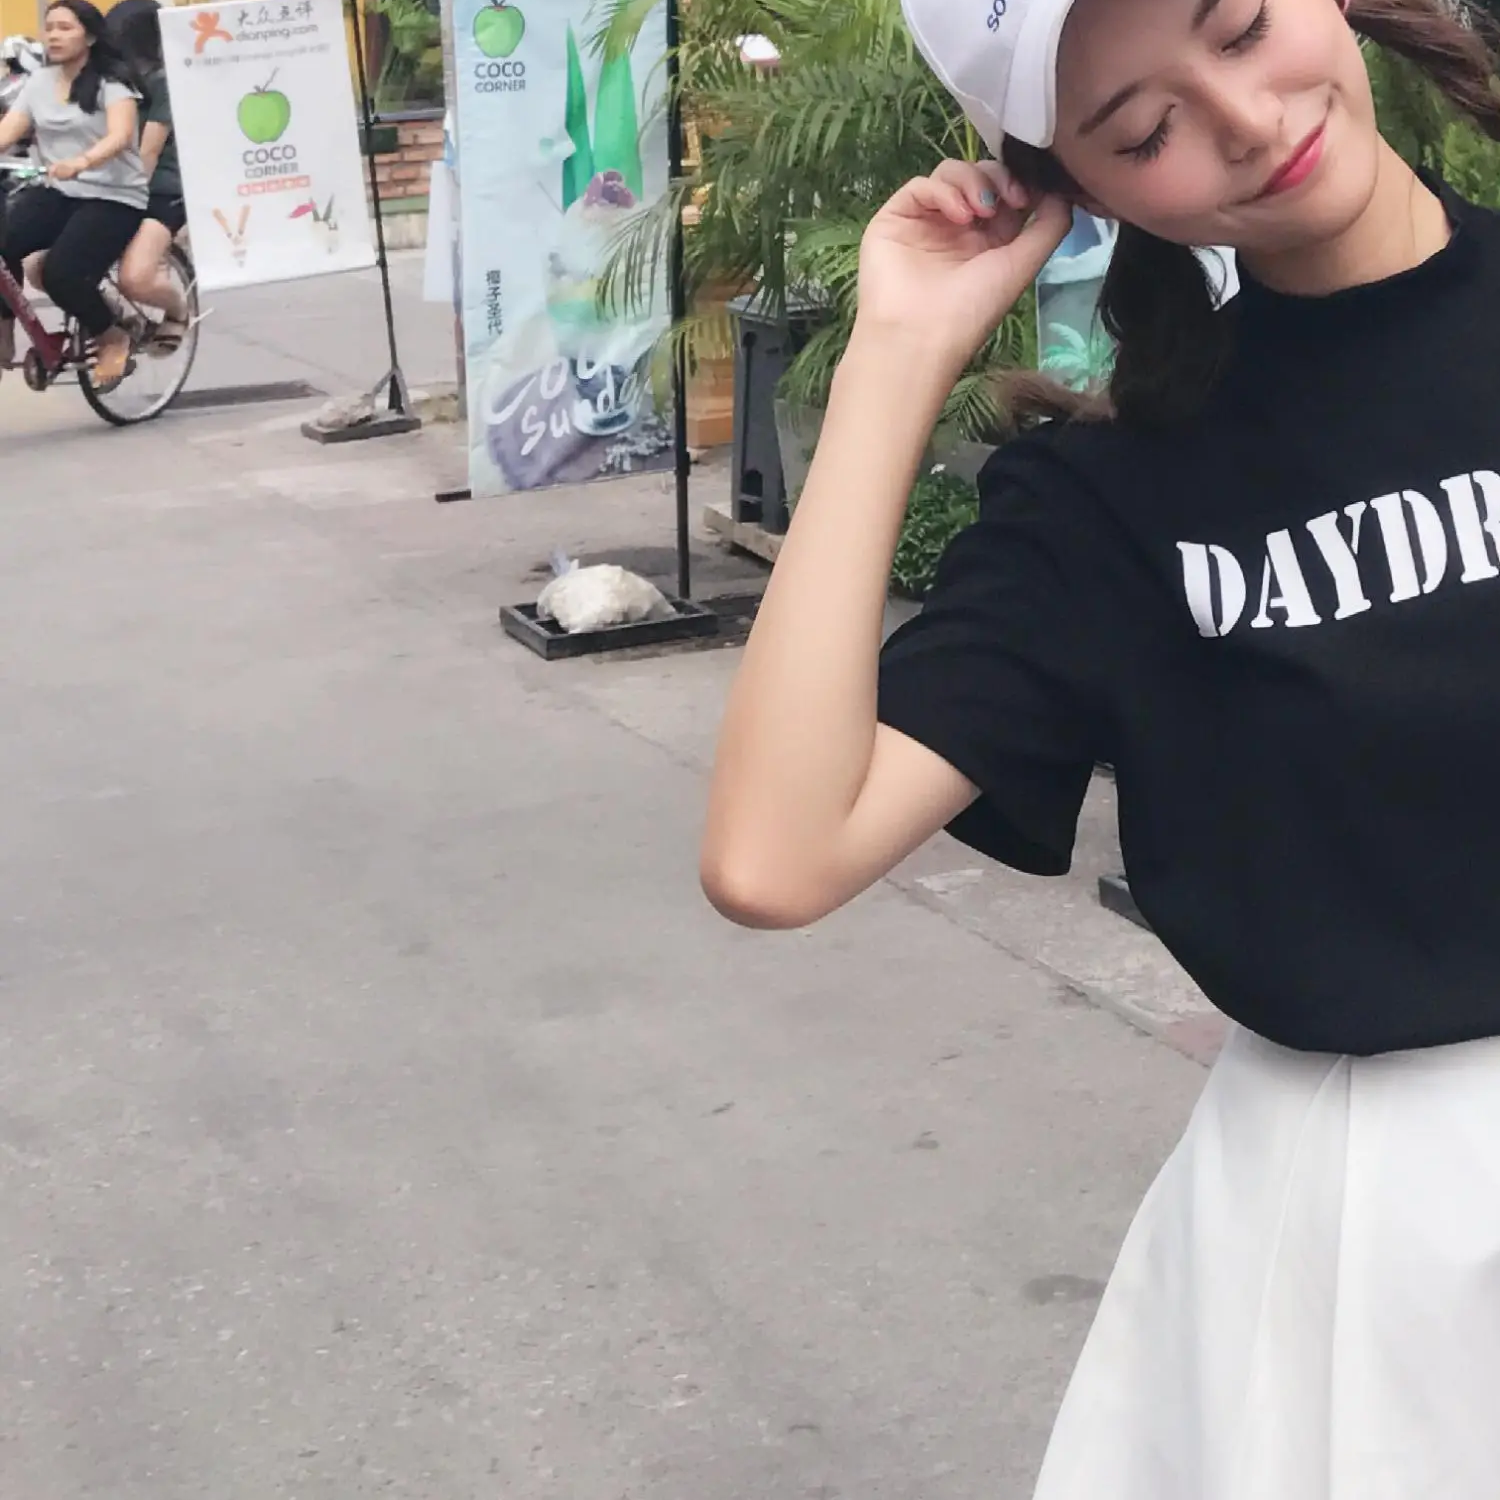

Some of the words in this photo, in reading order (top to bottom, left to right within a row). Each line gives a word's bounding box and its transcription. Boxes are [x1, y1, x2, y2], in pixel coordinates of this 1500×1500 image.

[474, 61, 526, 79] COCO
[474, 80, 526, 93] CORNER
[242, 145, 297, 166] COCO
[244, 162, 299, 179] CORNER
